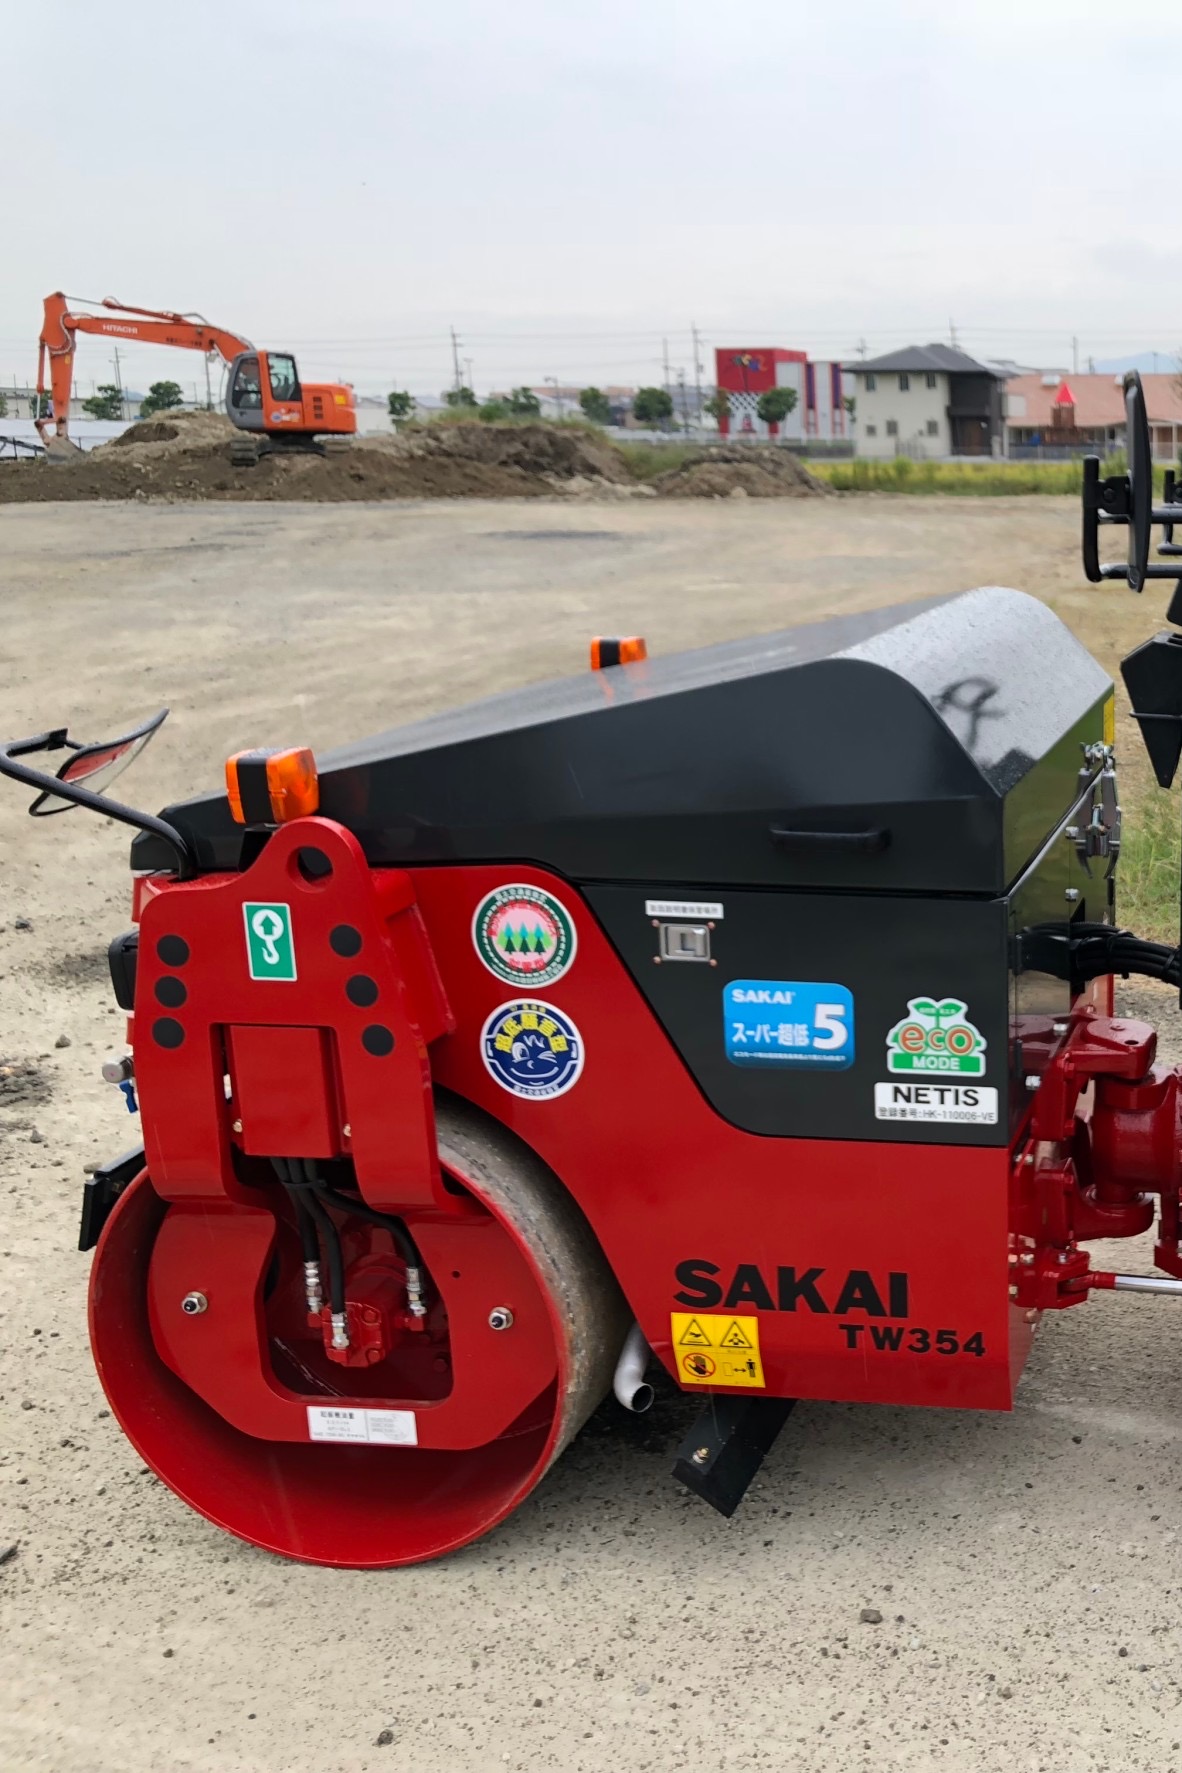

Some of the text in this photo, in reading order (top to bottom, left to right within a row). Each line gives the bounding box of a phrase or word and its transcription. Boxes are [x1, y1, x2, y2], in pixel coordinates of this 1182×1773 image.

[103, 324, 138, 334] HITACHI
[731, 988, 792, 1005] SAKAI
[813, 1003, 848, 1050] 5
[898, 1022, 977, 1056] eco
[912, 1055, 960, 1070] MODE
[893, 1085, 979, 1107] NETIS
[673, 1258, 909, 1318] SAKAI
[839, 1323, 986, 1357] TW354
